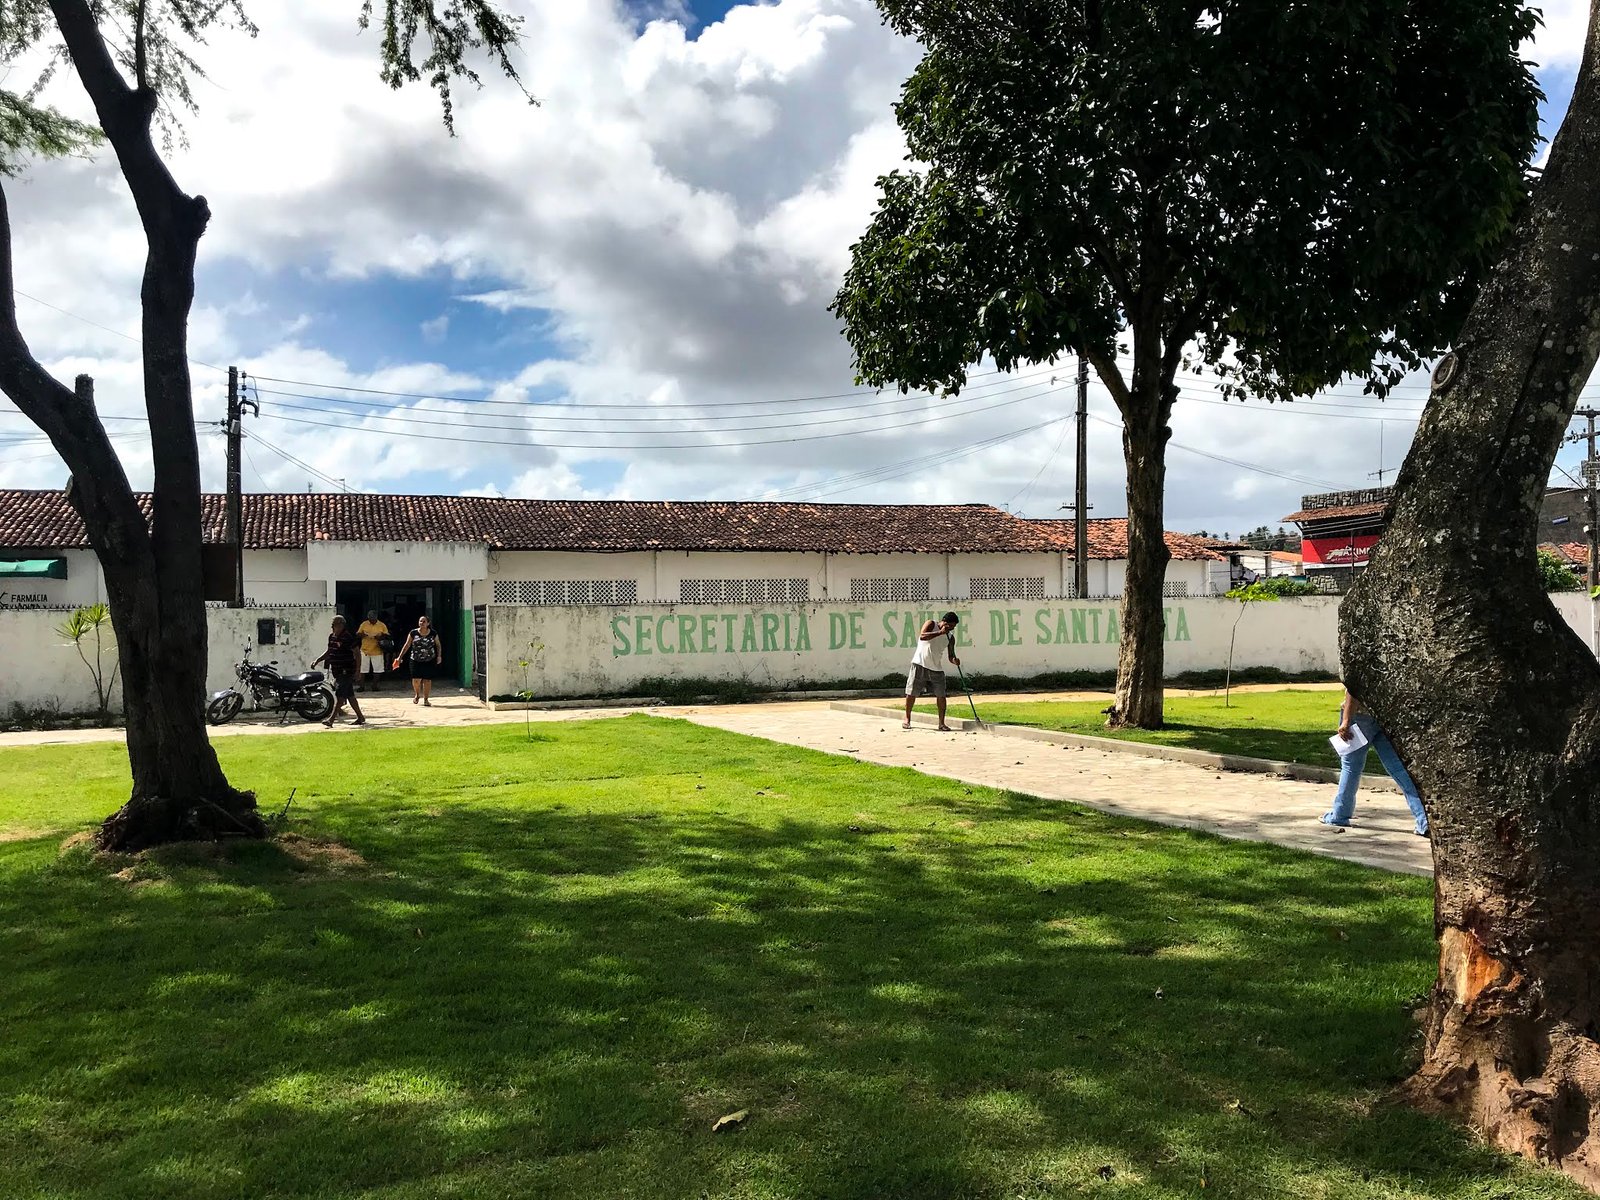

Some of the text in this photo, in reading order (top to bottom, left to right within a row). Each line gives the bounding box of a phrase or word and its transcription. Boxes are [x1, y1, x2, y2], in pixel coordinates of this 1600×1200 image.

[611, 613, 813, 656] SECRETARIA
[828, 611, 866, 650] DE
[882, 604, 973, 648] SAE
[989, 609, 1023, 647] DE
[1035, 608, 1119, 645] SANTA
